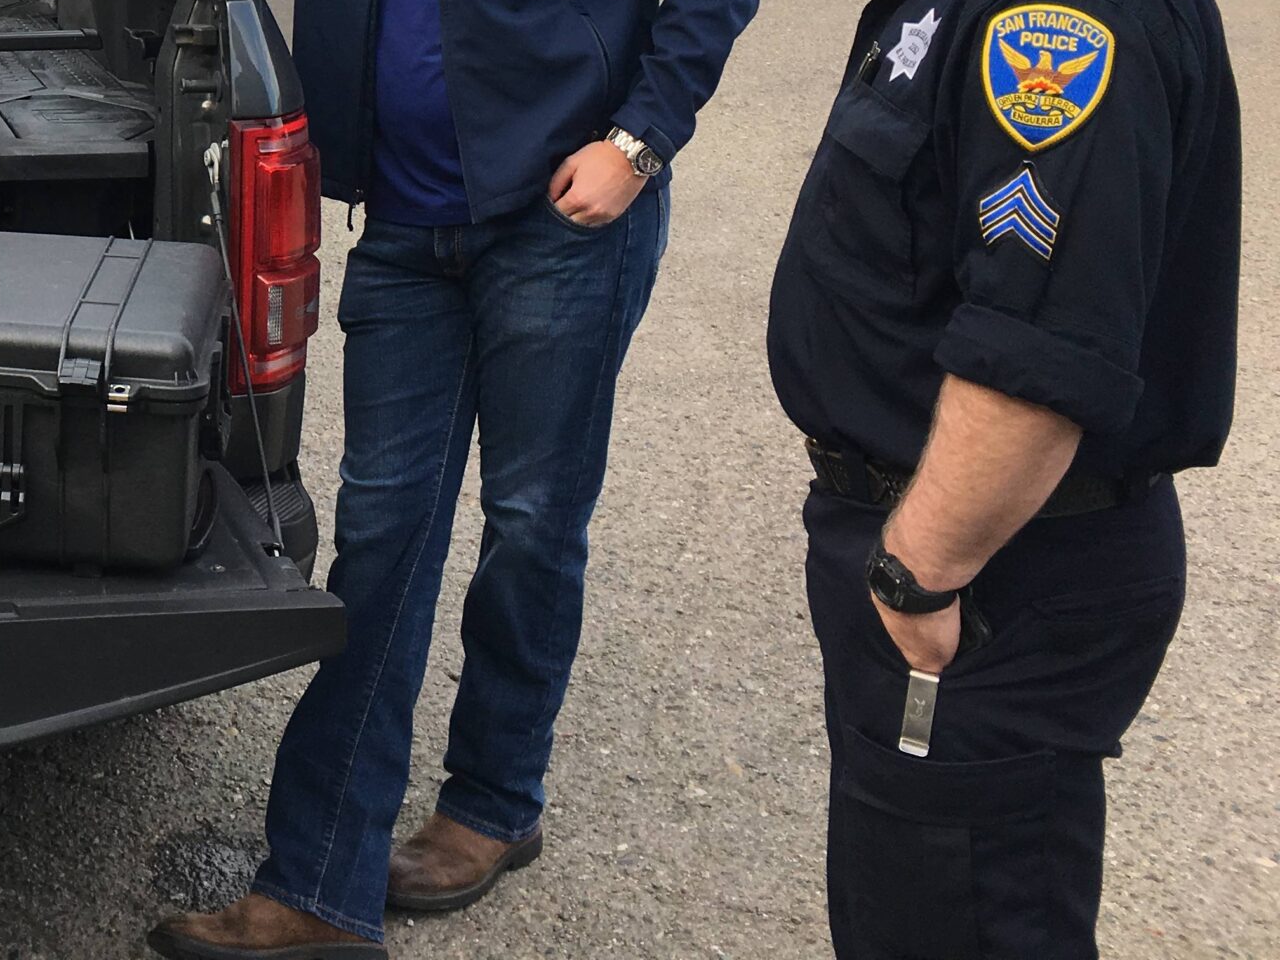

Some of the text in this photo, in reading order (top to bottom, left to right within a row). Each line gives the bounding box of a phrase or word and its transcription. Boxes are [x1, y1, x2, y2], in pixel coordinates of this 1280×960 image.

[995, 12, 1107, 48] SAN FRANCISCO
[1020, 31, 1079, 51] POLICE
